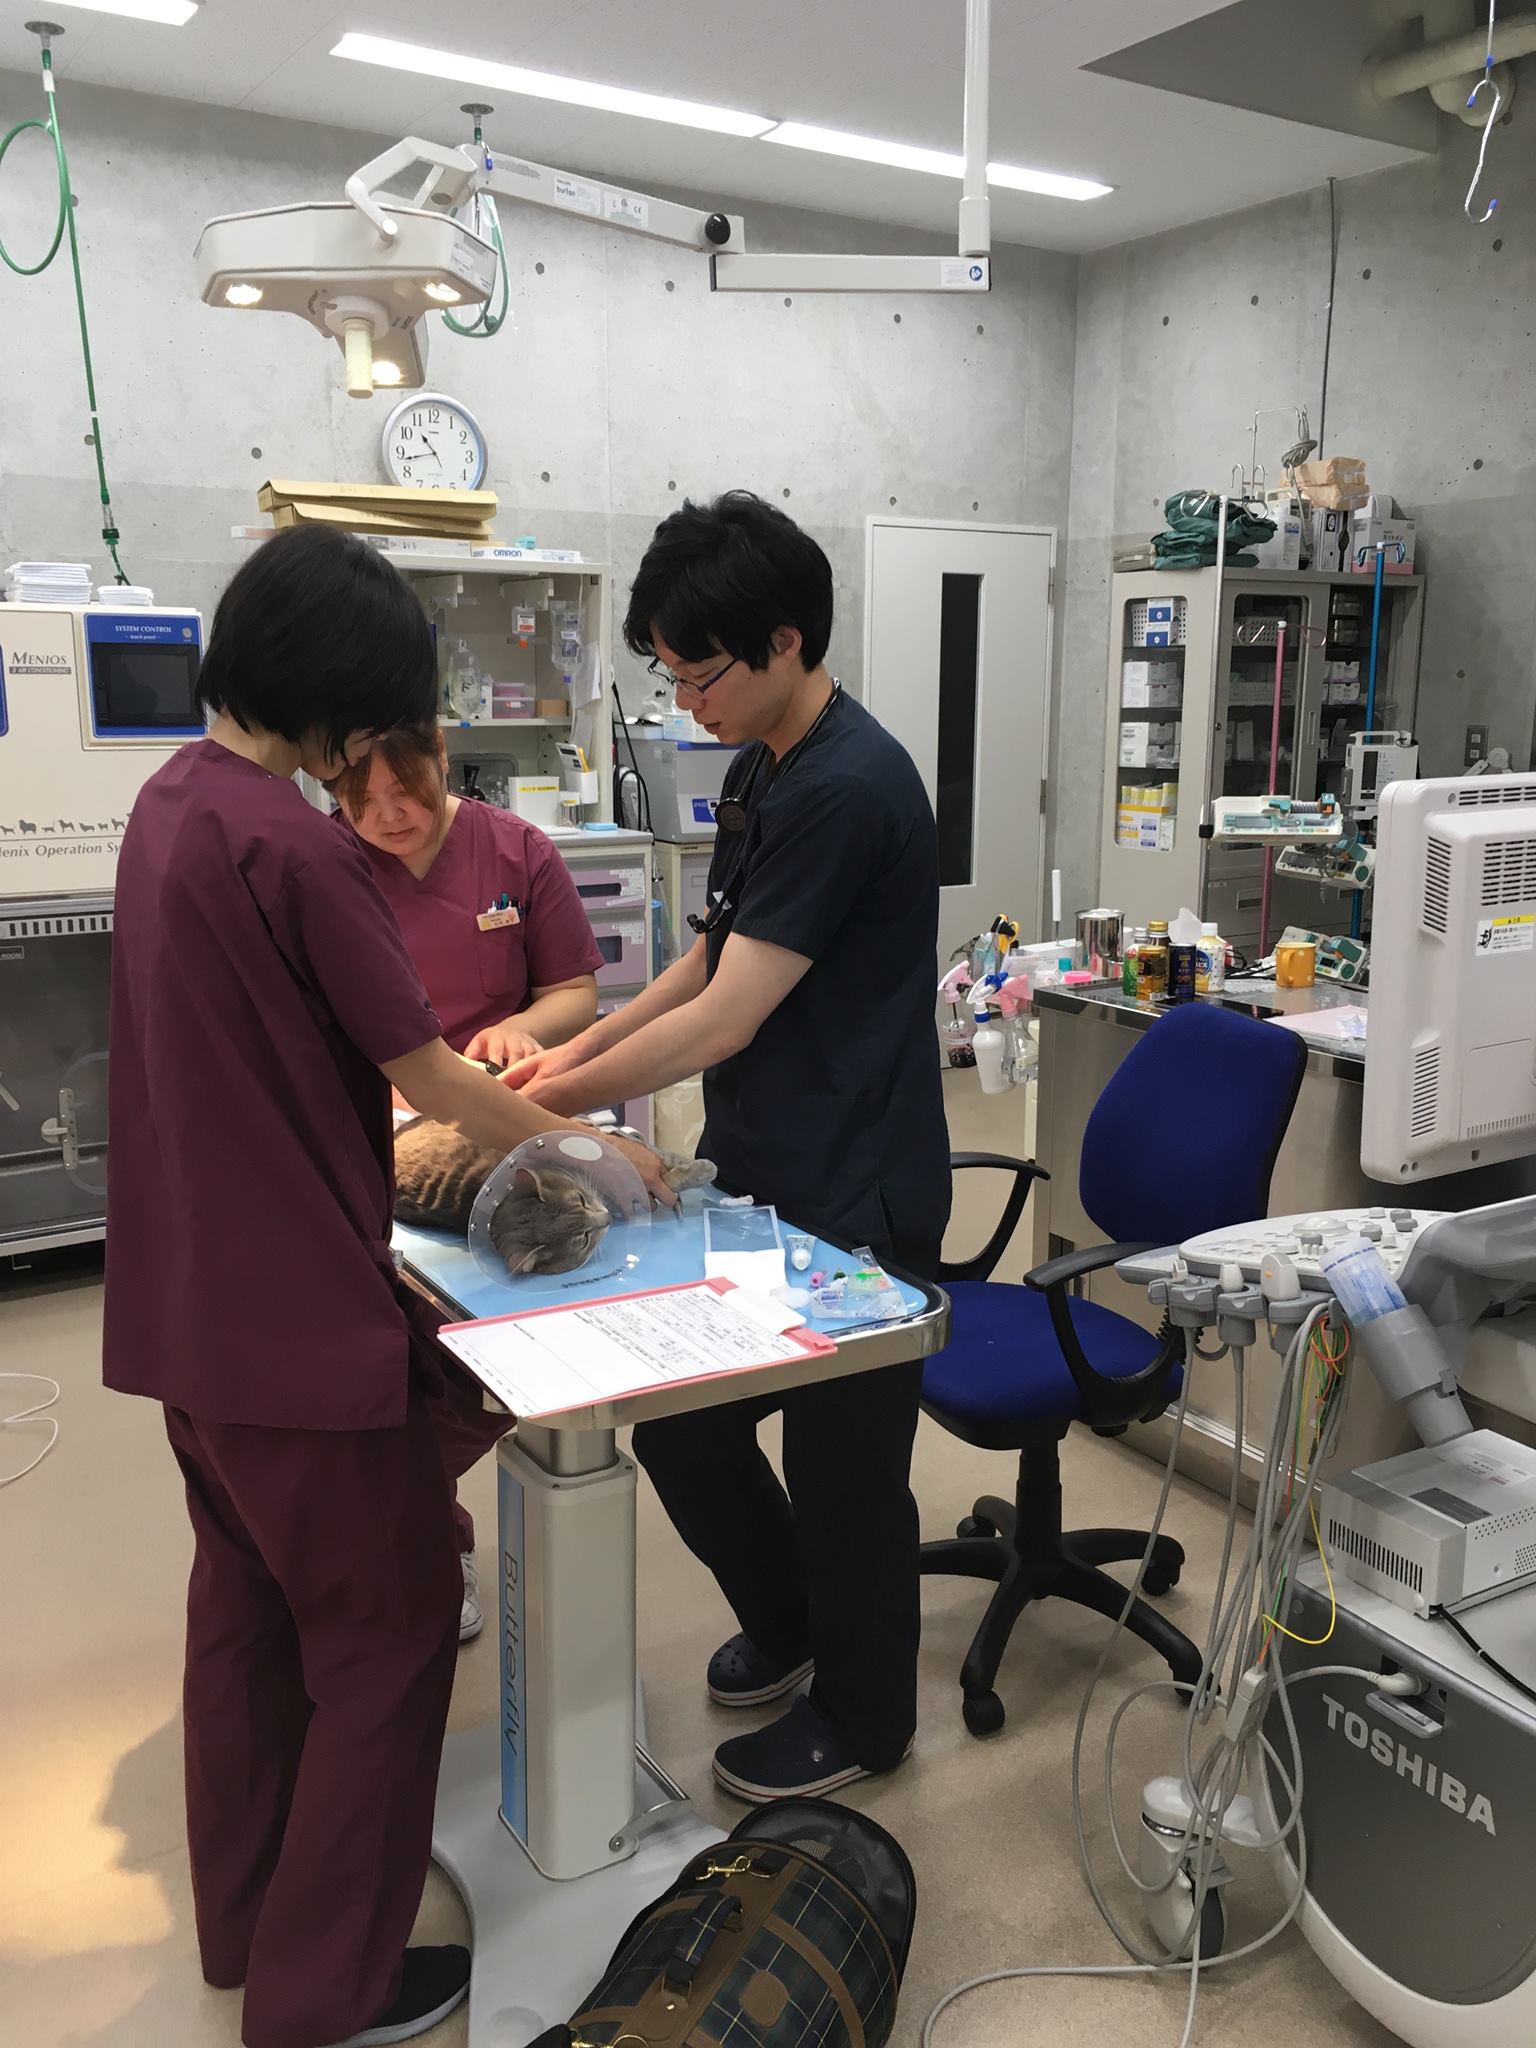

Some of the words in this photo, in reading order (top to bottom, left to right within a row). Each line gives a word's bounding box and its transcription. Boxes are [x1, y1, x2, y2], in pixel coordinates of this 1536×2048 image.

[412, 412, 423, 427] 11
[428, 408, 440, 424] 12
[449, 415, 454, 430] 1
[400, 426, 413, 440] 10
[459, 431, 467, 445] 2
[395, 445, 406, 460] 9
[464, 450, 474, 464] 3
[403, 465, 412, 479] 8
[460, 468, 467, 481] 4
[493, 549, 522, 557] OMRON
[12, 651, 67, 665] MENIOS
[35, 842, 102, 858] Operation
[504, 1550, 520, 1757] Butterfly
[1322, 1694, 1497, 1836] TOSHIBA
